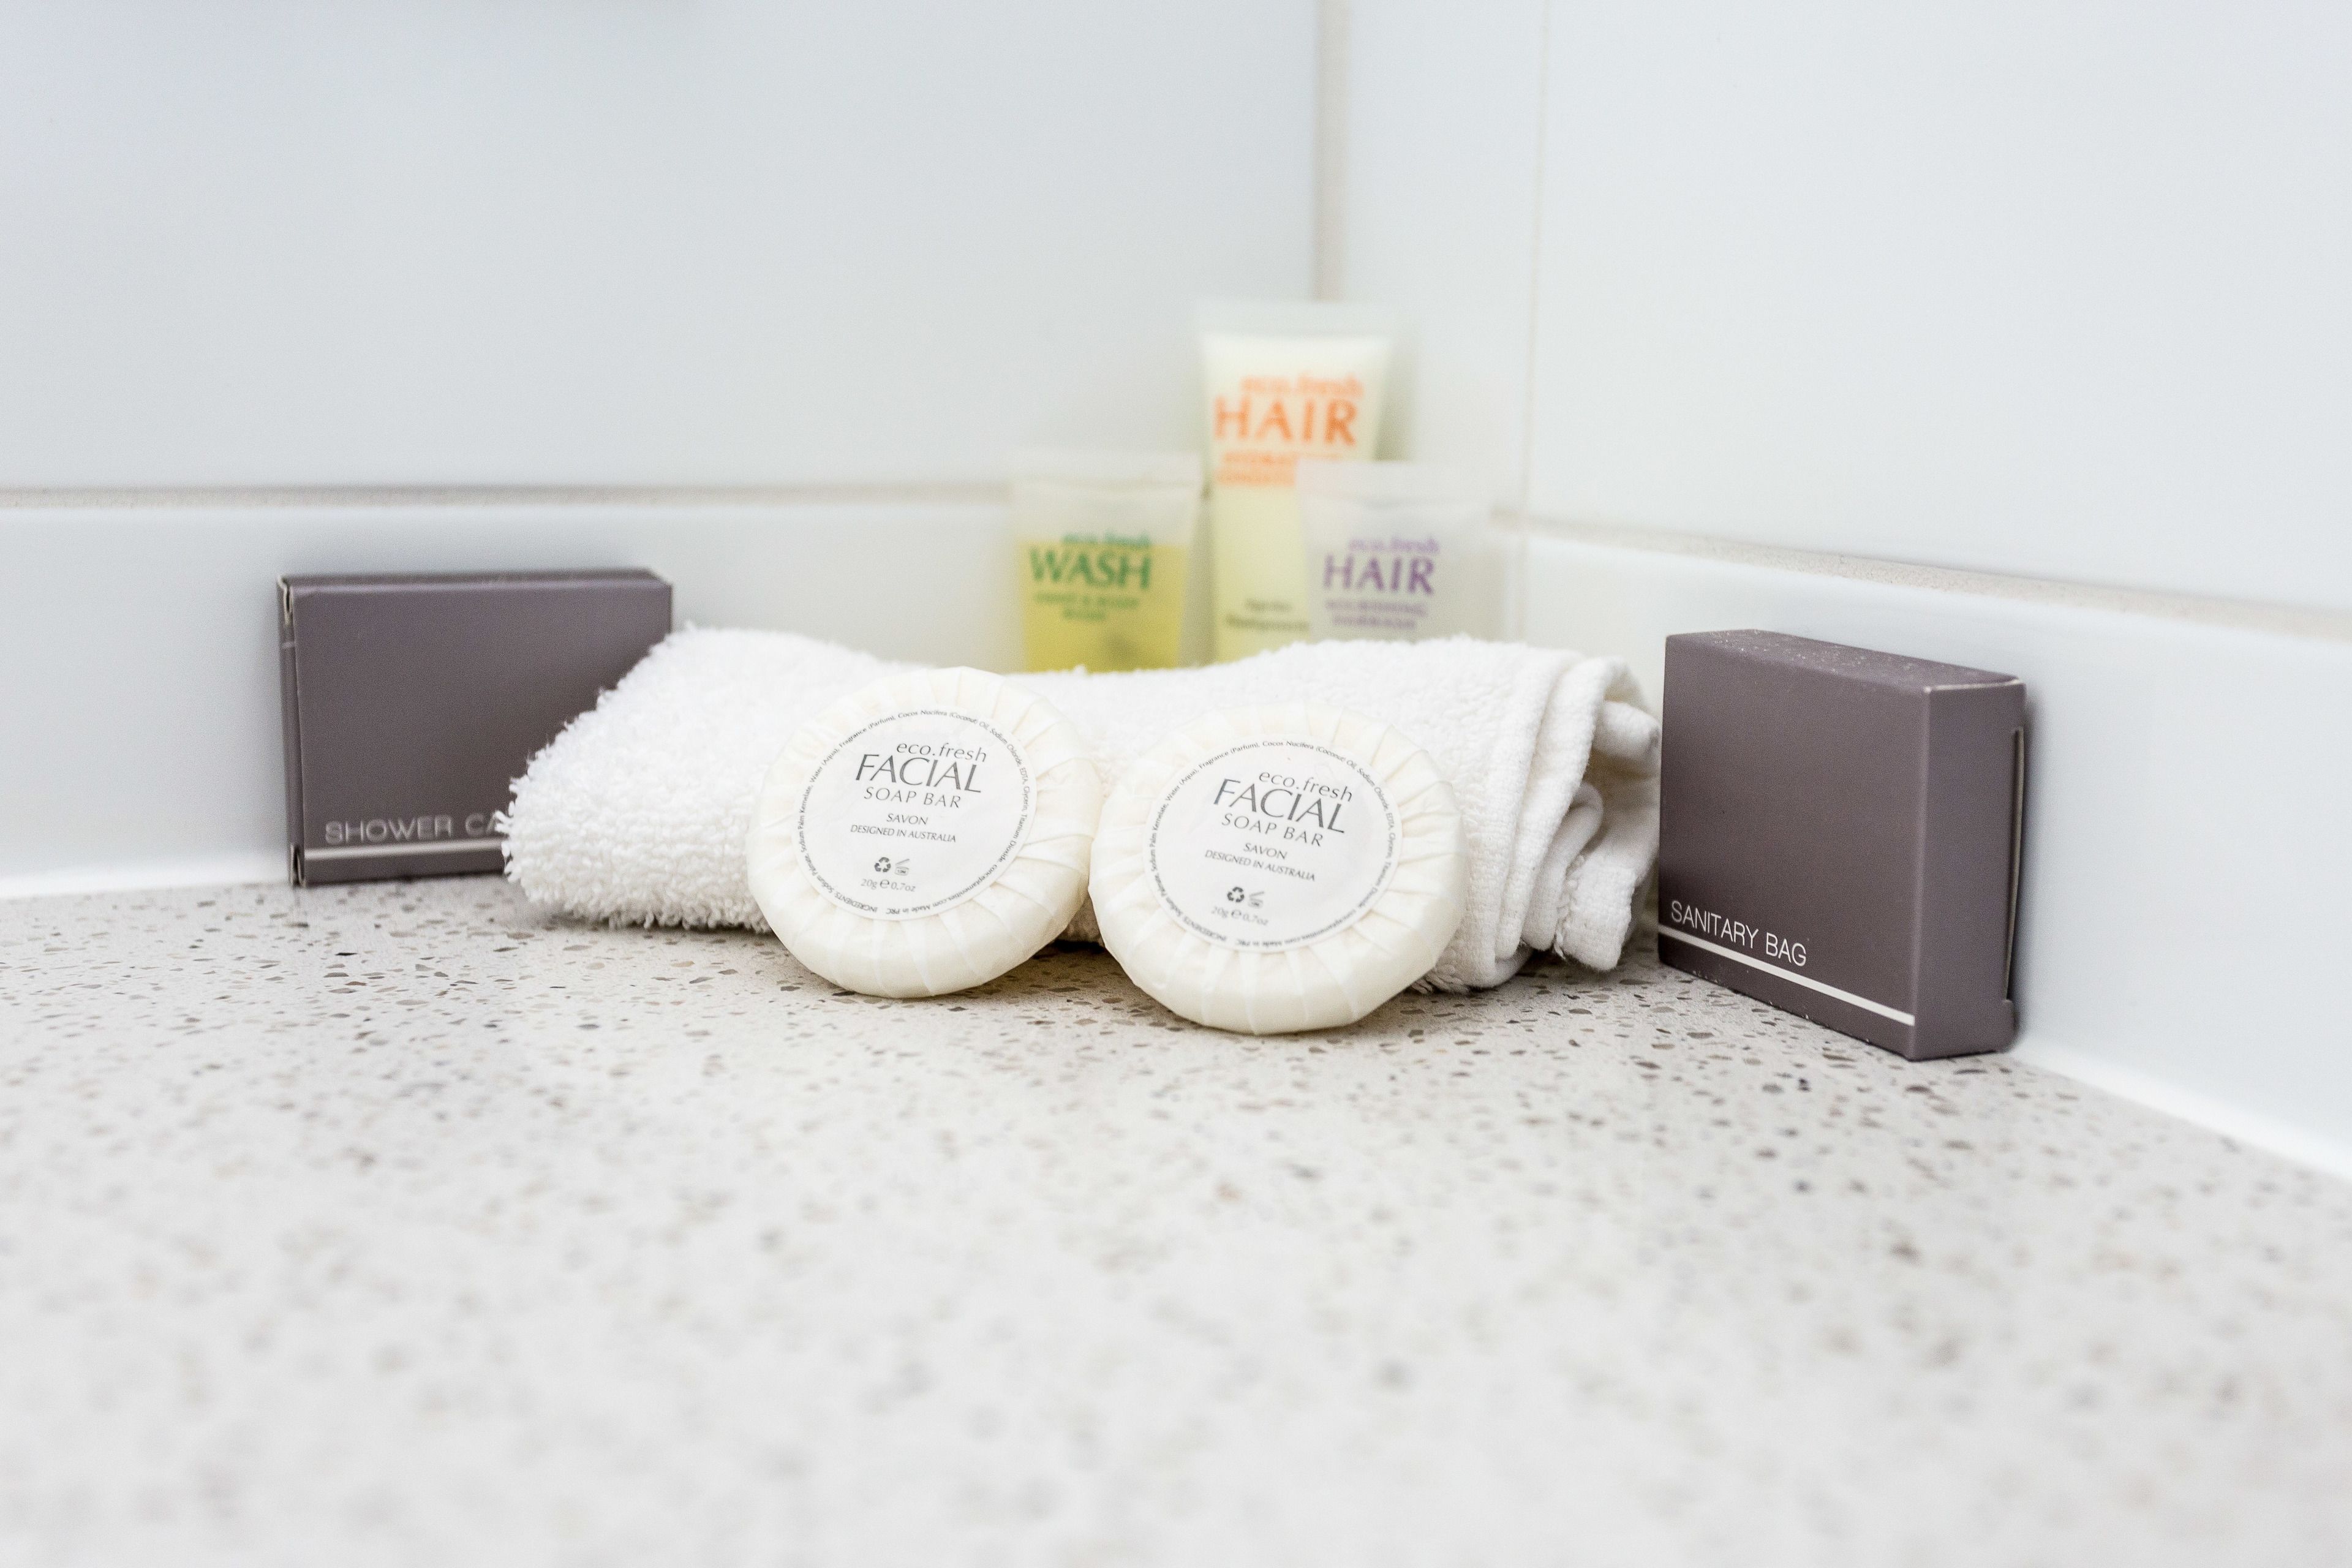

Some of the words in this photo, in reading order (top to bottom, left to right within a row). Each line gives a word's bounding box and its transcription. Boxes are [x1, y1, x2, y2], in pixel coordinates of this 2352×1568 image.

[1214, 396, 1357, 447] HAIR
[1029, 548, 1152, 590] WASH
[1323, 554, 1434, 595] HAIR
[838, 728, 867, 748] Fragrance
[989, 728, 1008, 745] Sodium
[896, 742, 987, 763] eco.fresh
[809, 766, 823, 783] Water
[856, 754, 981, 793] FACIAL
[1165, 785, 1181, 802] Water
[1198, 752, 1229, 769] Fragrance
[1286, 740, 1314, 750] Nucifera
[1357, 767, 1376, 788] Sodium
[864, 786, 917, 803] SOAP
[924, 793, 961, 809] BAR
[1259, 771, 1352, 802] eco.fresh
[886, 813, 929, 825] SAVON
[1213, 778, 1344, 834] FACIAL
[325, 815, 453, 845] SHOWER
[850, 824, 895, 837] DESIGNED
[897, 829, 907, 838] IN
[908, 831, 957, 843] AUSTRALIA
[1012, 813, 1028, 839] Titanium
[1221, 813, 1277, 834] SOAP
[1283, 826, 1324, 846] BAR
[798, 831, 807, 853] Sodium
[1243, 842, 1287, 860] SAVON
[1205, 850, 1251, 867] DESIGNED
[1253, 859, 1264, 869] IN
[1265, 862, 1316, 881] AUSTRALIA
[861, 878, 878, 890] 20g
[891, 881, 916, 892] 0.7oz
[911, 903, 931, 913] Made
[1671, 900, 1759, 949] SANITARY
[1765, 932, 1807, 967] BAG
